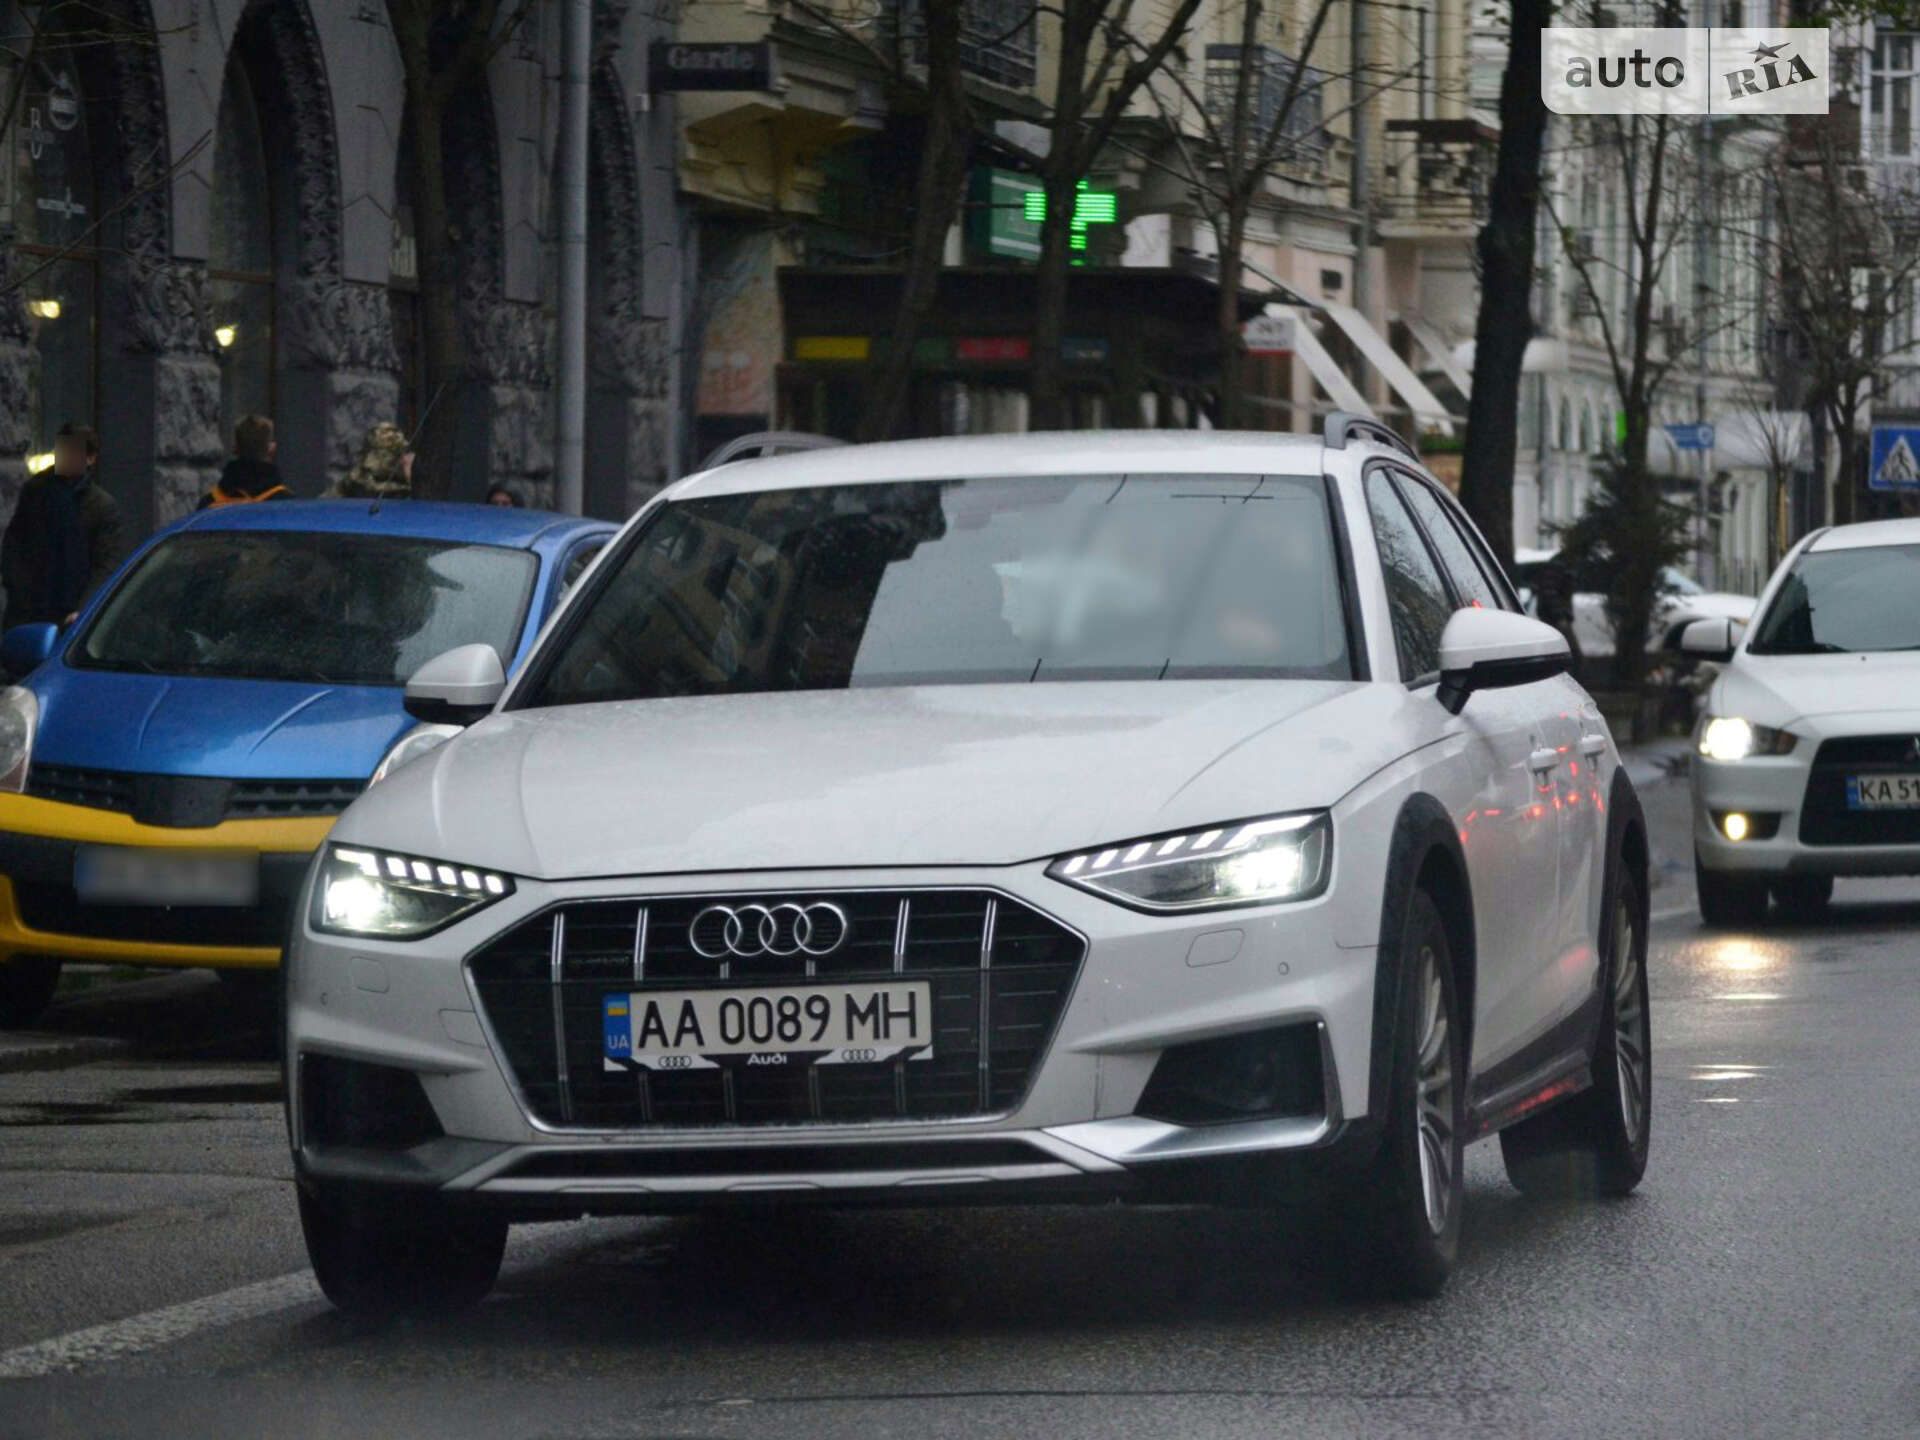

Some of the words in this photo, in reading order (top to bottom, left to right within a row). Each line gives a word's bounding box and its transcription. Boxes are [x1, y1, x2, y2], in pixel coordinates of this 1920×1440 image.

[1860, 780, 1893, 801] KA
[638, 999, 705, 1049] AA
[719, 994, 831, 1044] 0089
[845, 991, 917, 1042] MH
[607, 1034, 630, 1050] UA
[747, 1052, 787, 1066] Audi
